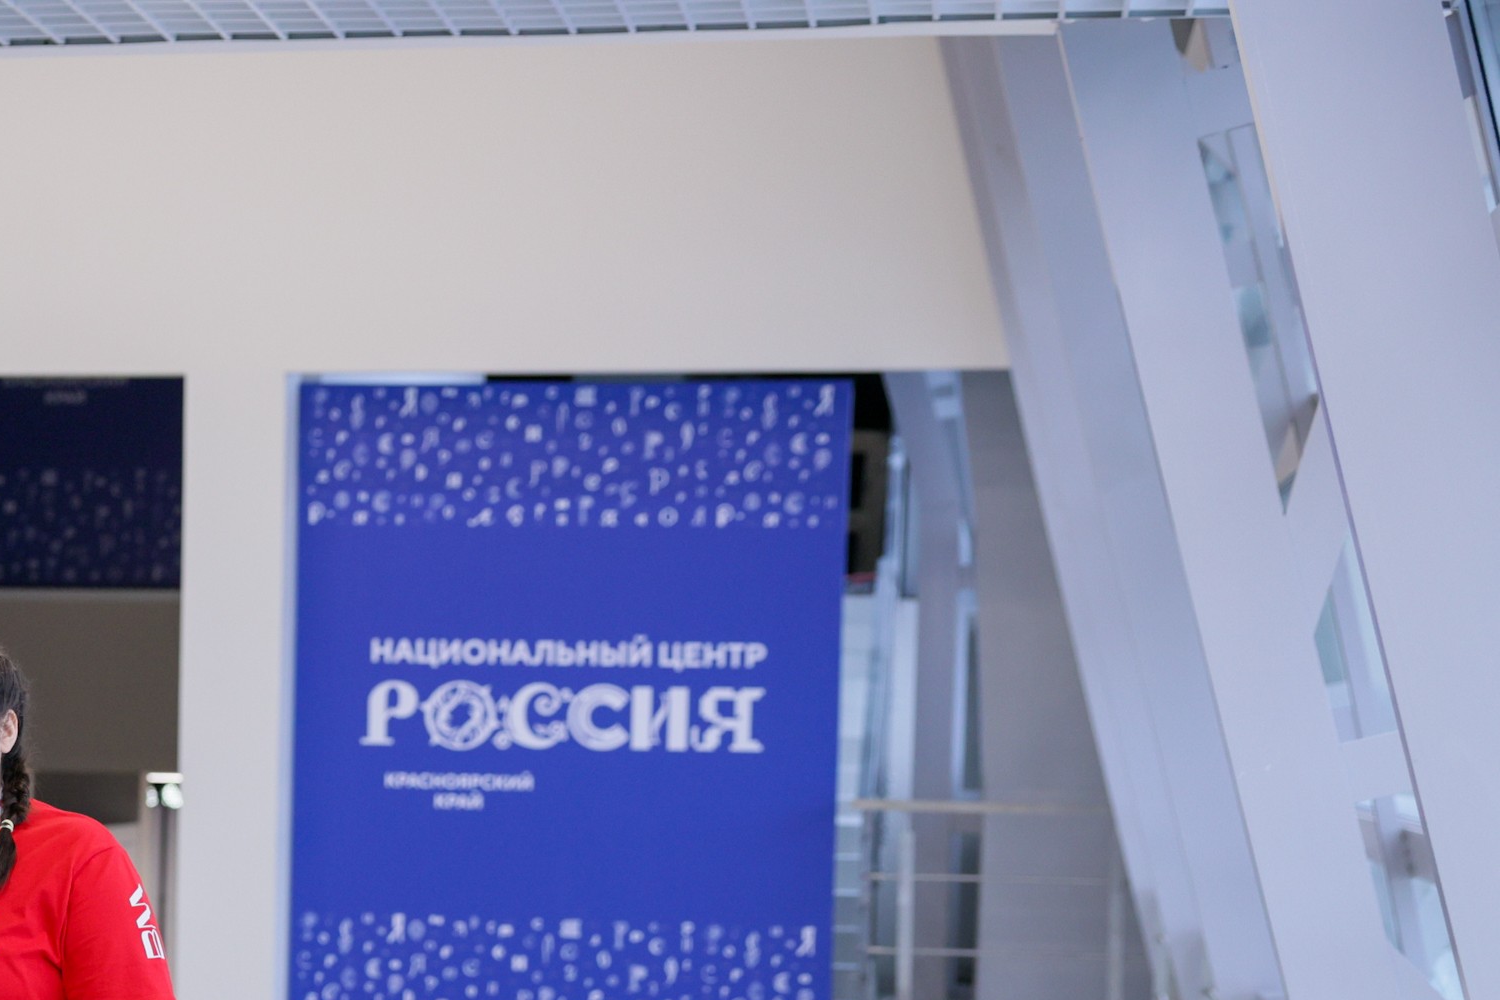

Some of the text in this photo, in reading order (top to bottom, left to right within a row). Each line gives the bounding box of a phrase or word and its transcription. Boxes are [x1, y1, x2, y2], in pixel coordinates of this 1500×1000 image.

[370, 634, 768, 672] НАЦИОНАЛЬНЫЙ ЦЕНТР
[359, 678, 766, 754] РОССИЯ
[383, 770, 535, 792] КРАСНОЯРСКИЙ
[432, 789, 485, 811] КРАЙ
